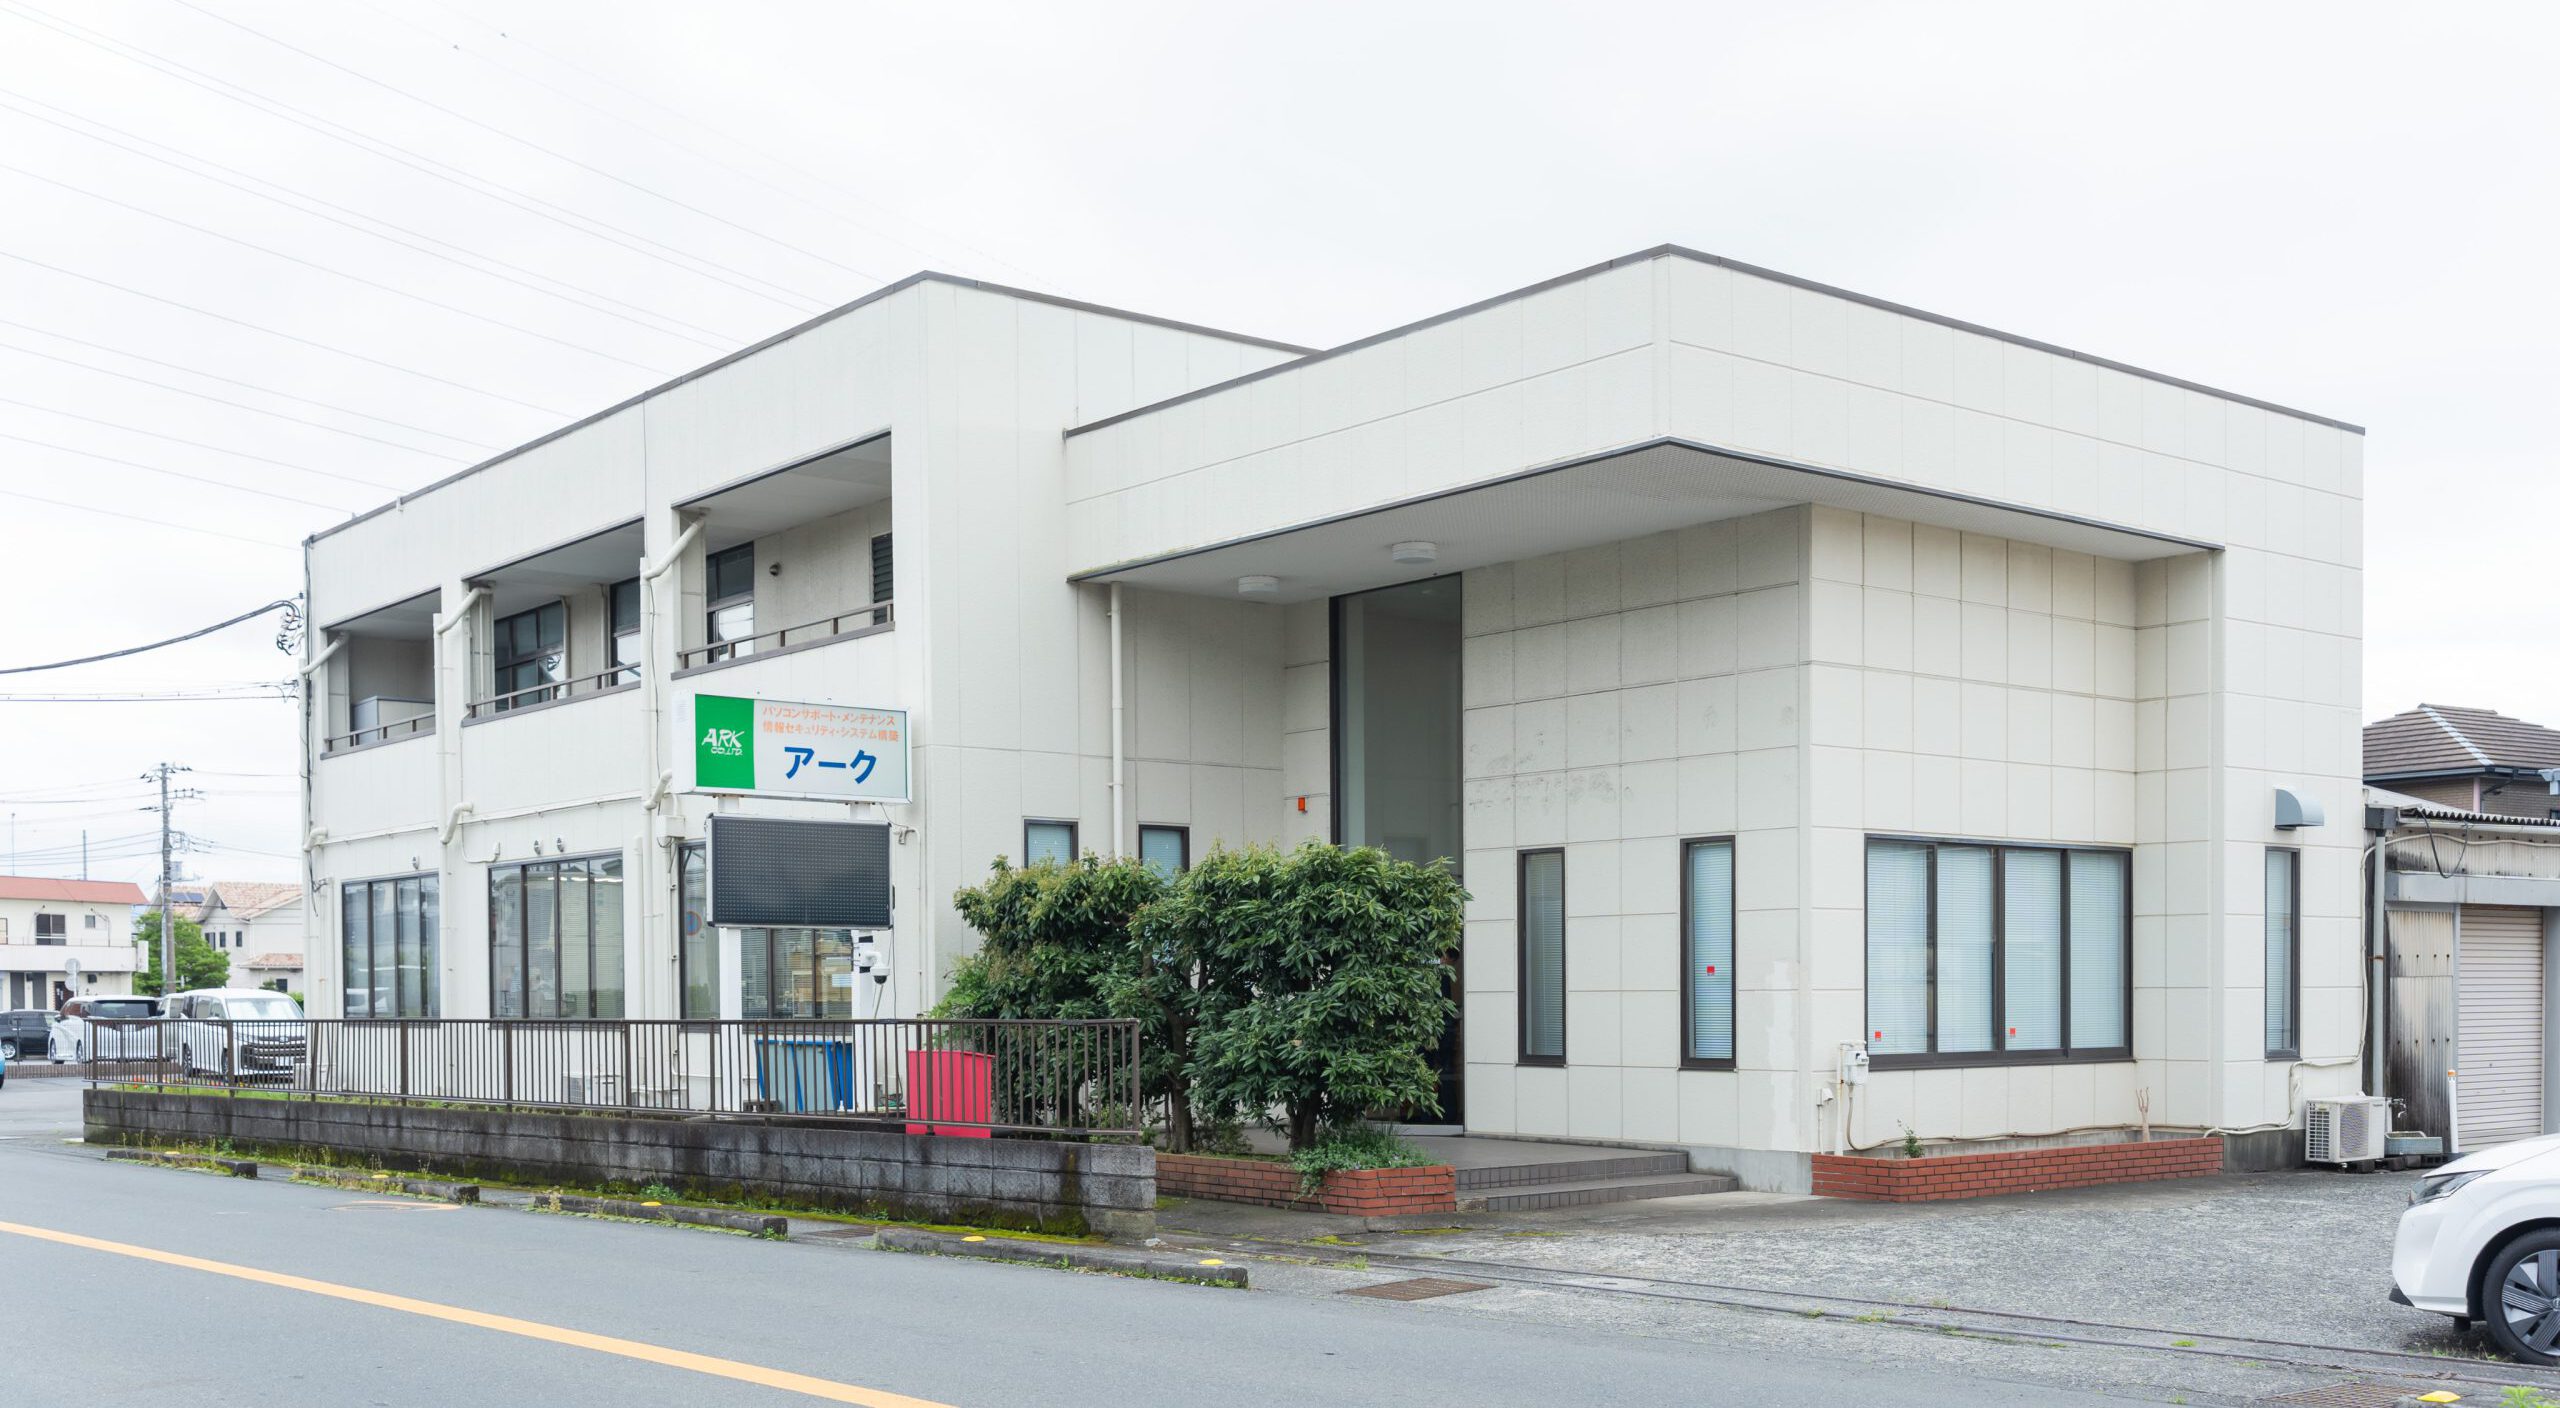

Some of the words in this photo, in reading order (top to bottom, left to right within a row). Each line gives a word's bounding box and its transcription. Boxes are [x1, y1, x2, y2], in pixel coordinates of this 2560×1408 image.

[762, 705, 896, 726] パソコンサポート・メンテナンス
[701, 728, 745, 748] ARK
[784, 746, 877, 785] アーク
